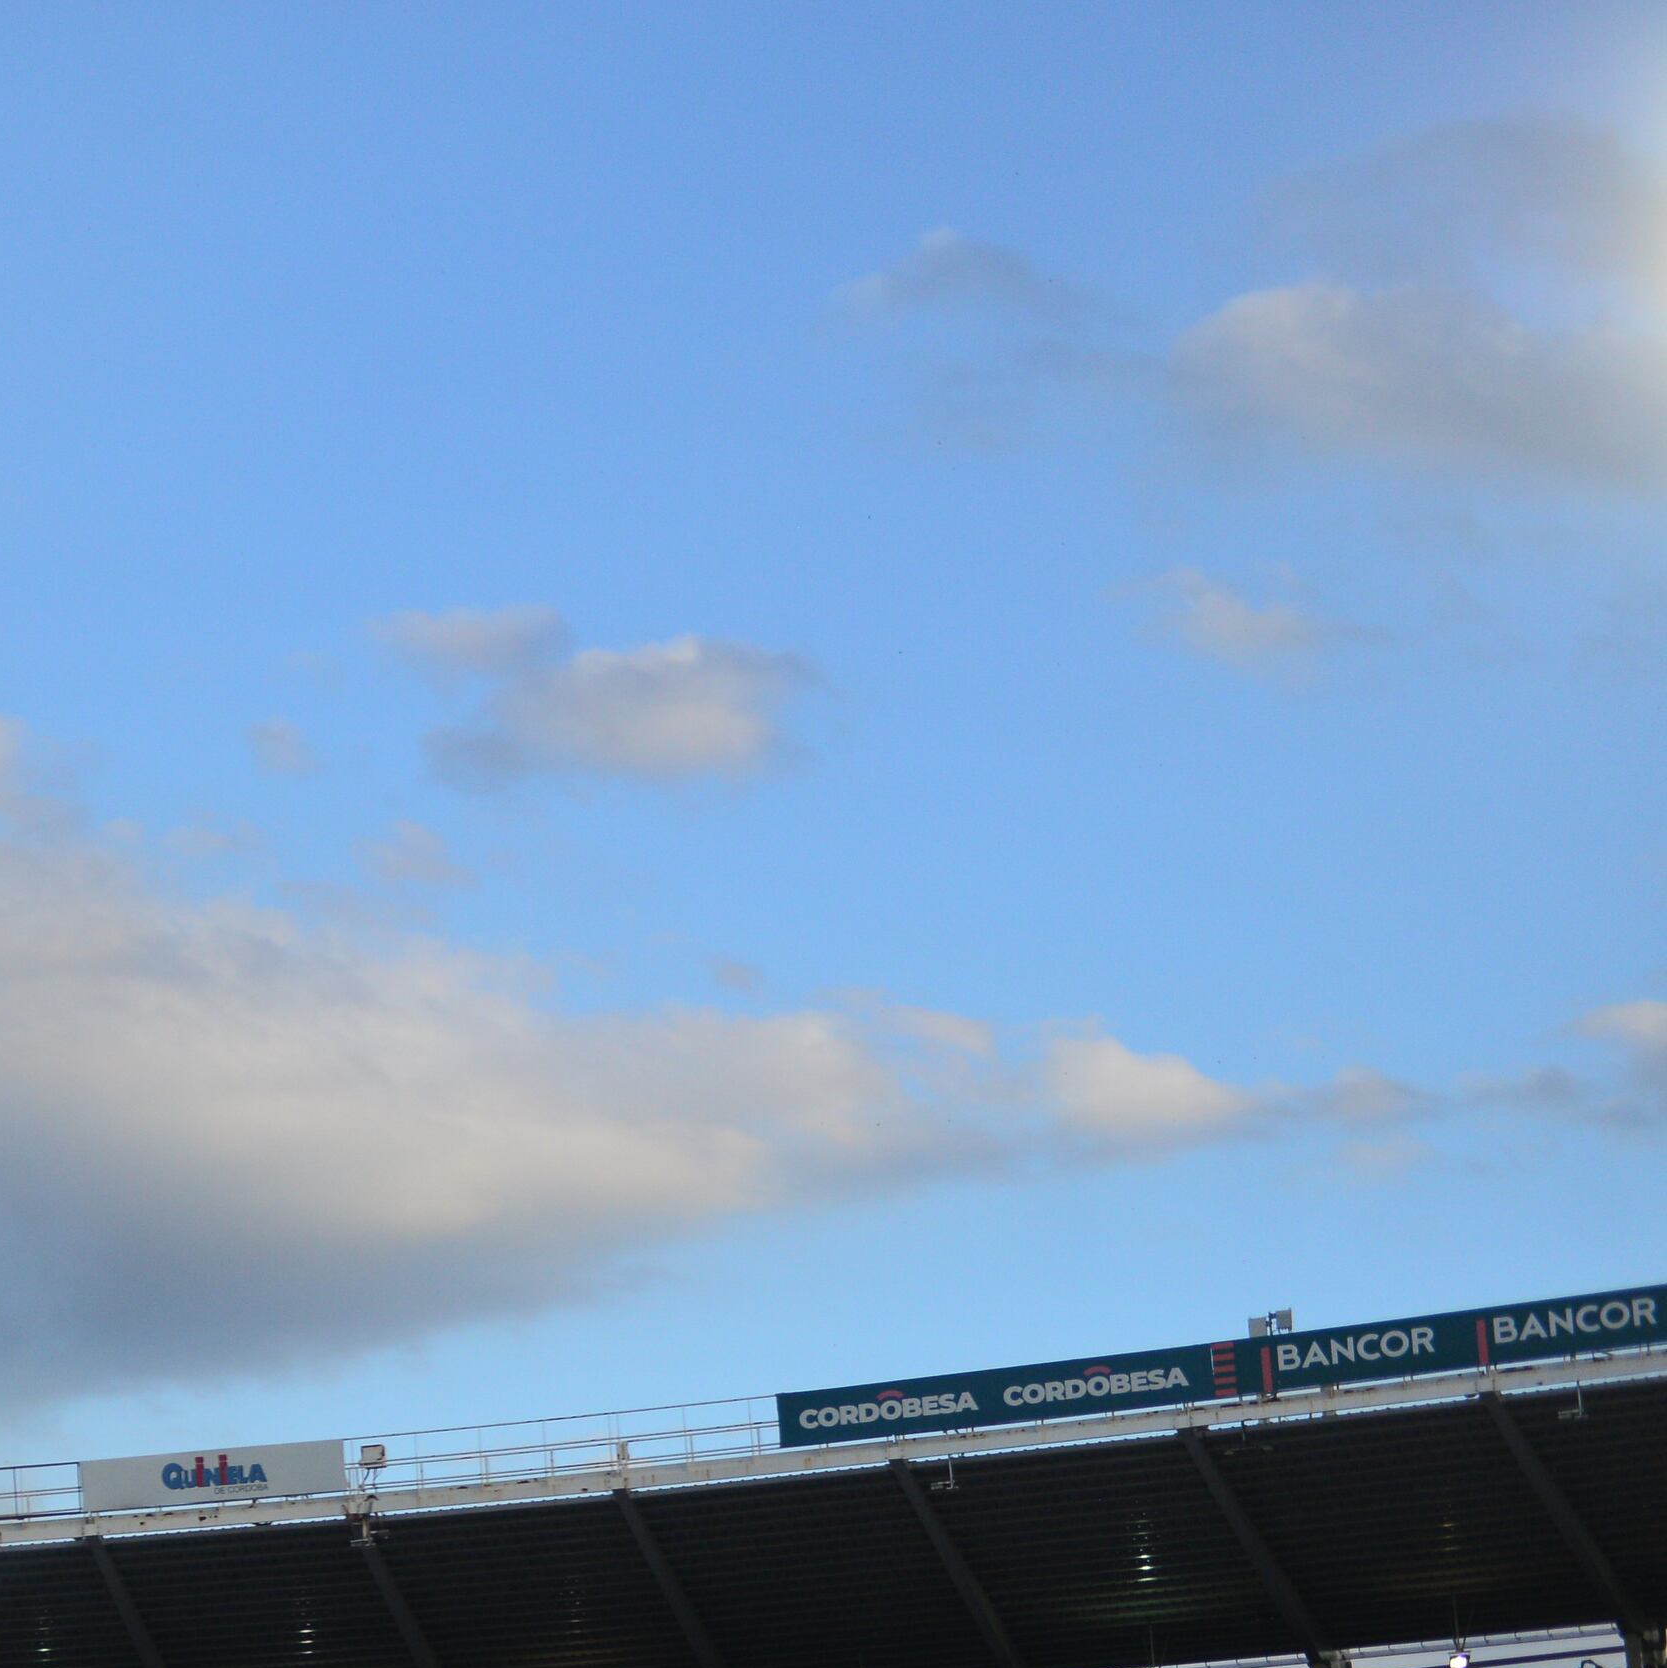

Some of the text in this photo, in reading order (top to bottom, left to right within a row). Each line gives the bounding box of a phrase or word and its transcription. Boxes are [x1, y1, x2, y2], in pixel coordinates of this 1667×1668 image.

[1493, 1297, 1657, 1345] BANCOR
[1277, 1326, 1435, 1371] BANCOR
[1003, 1366, 1189, 1407] CORDOBESA
[799, 1391, 978, 1430] CORDOBESA
